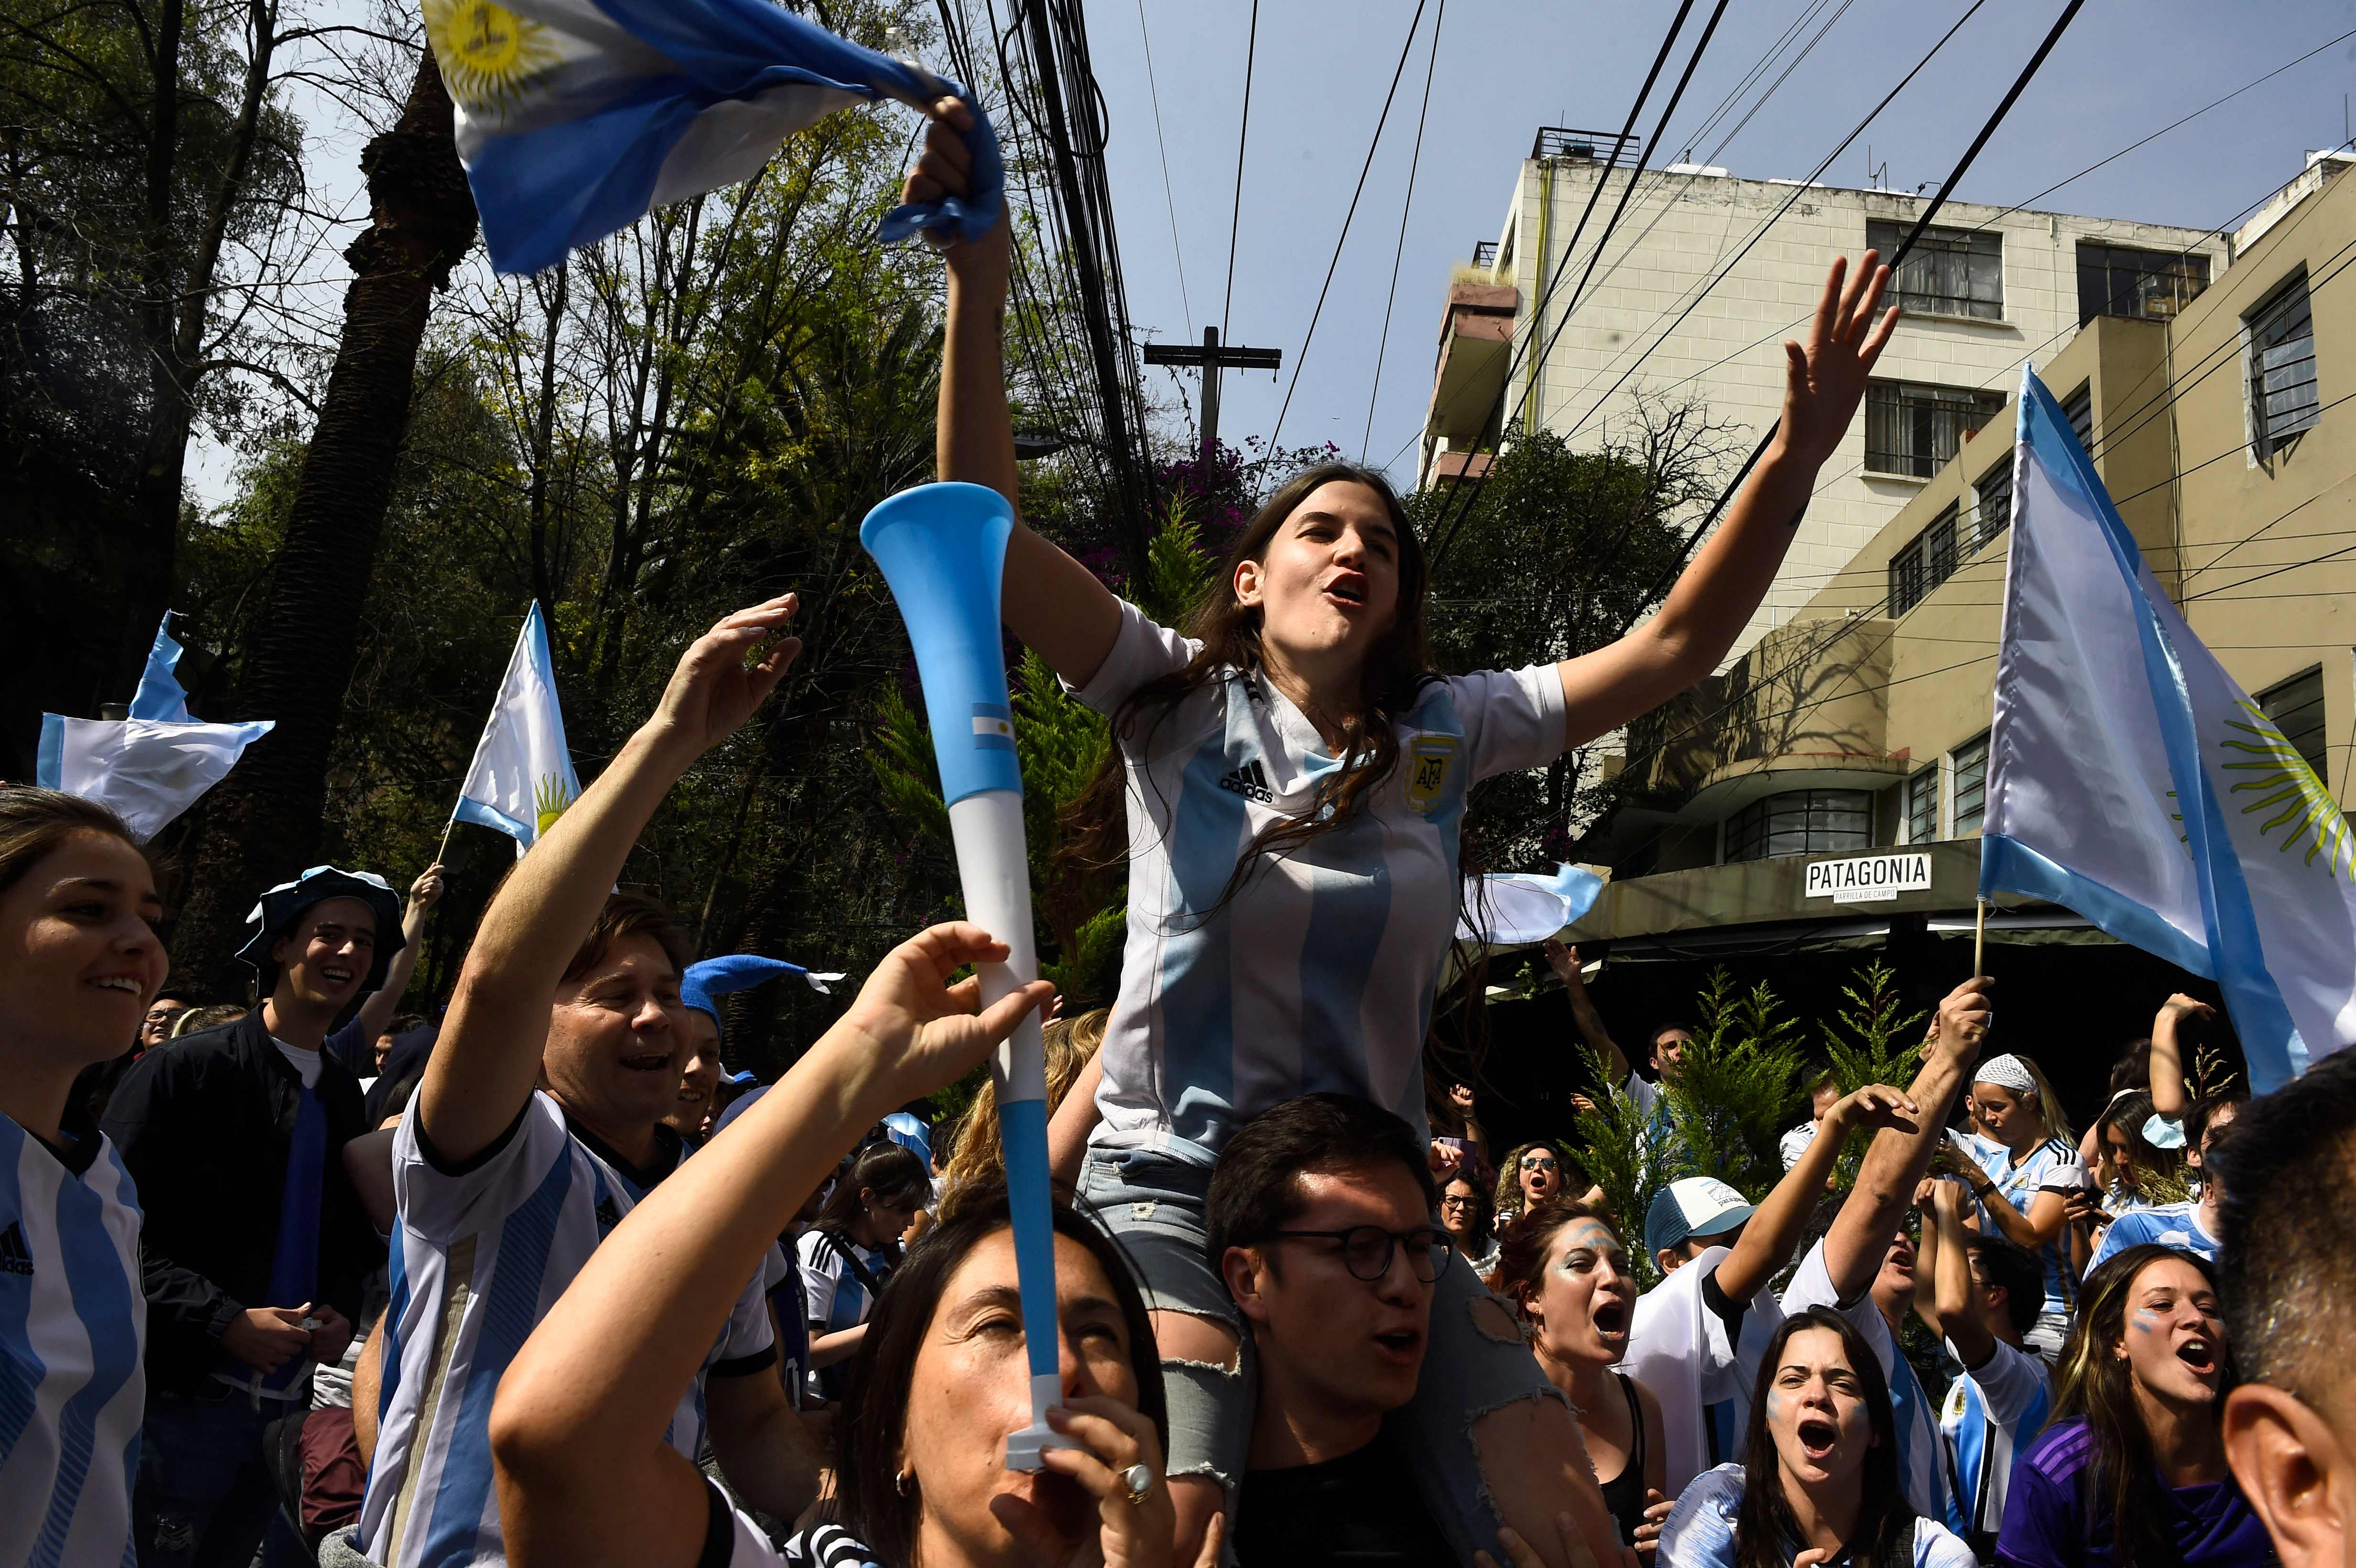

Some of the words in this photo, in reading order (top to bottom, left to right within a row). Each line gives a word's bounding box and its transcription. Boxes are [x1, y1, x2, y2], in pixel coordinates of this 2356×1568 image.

[1221, 778, 1273, 803] adidas
[1810, 856, 1926, 890] PATAGONIA
[1835, 892, 1862, 900] PARRILLA
[1865, 891, 1872, 899] DE
[1874, 889, 1895, 898] CAMPO
